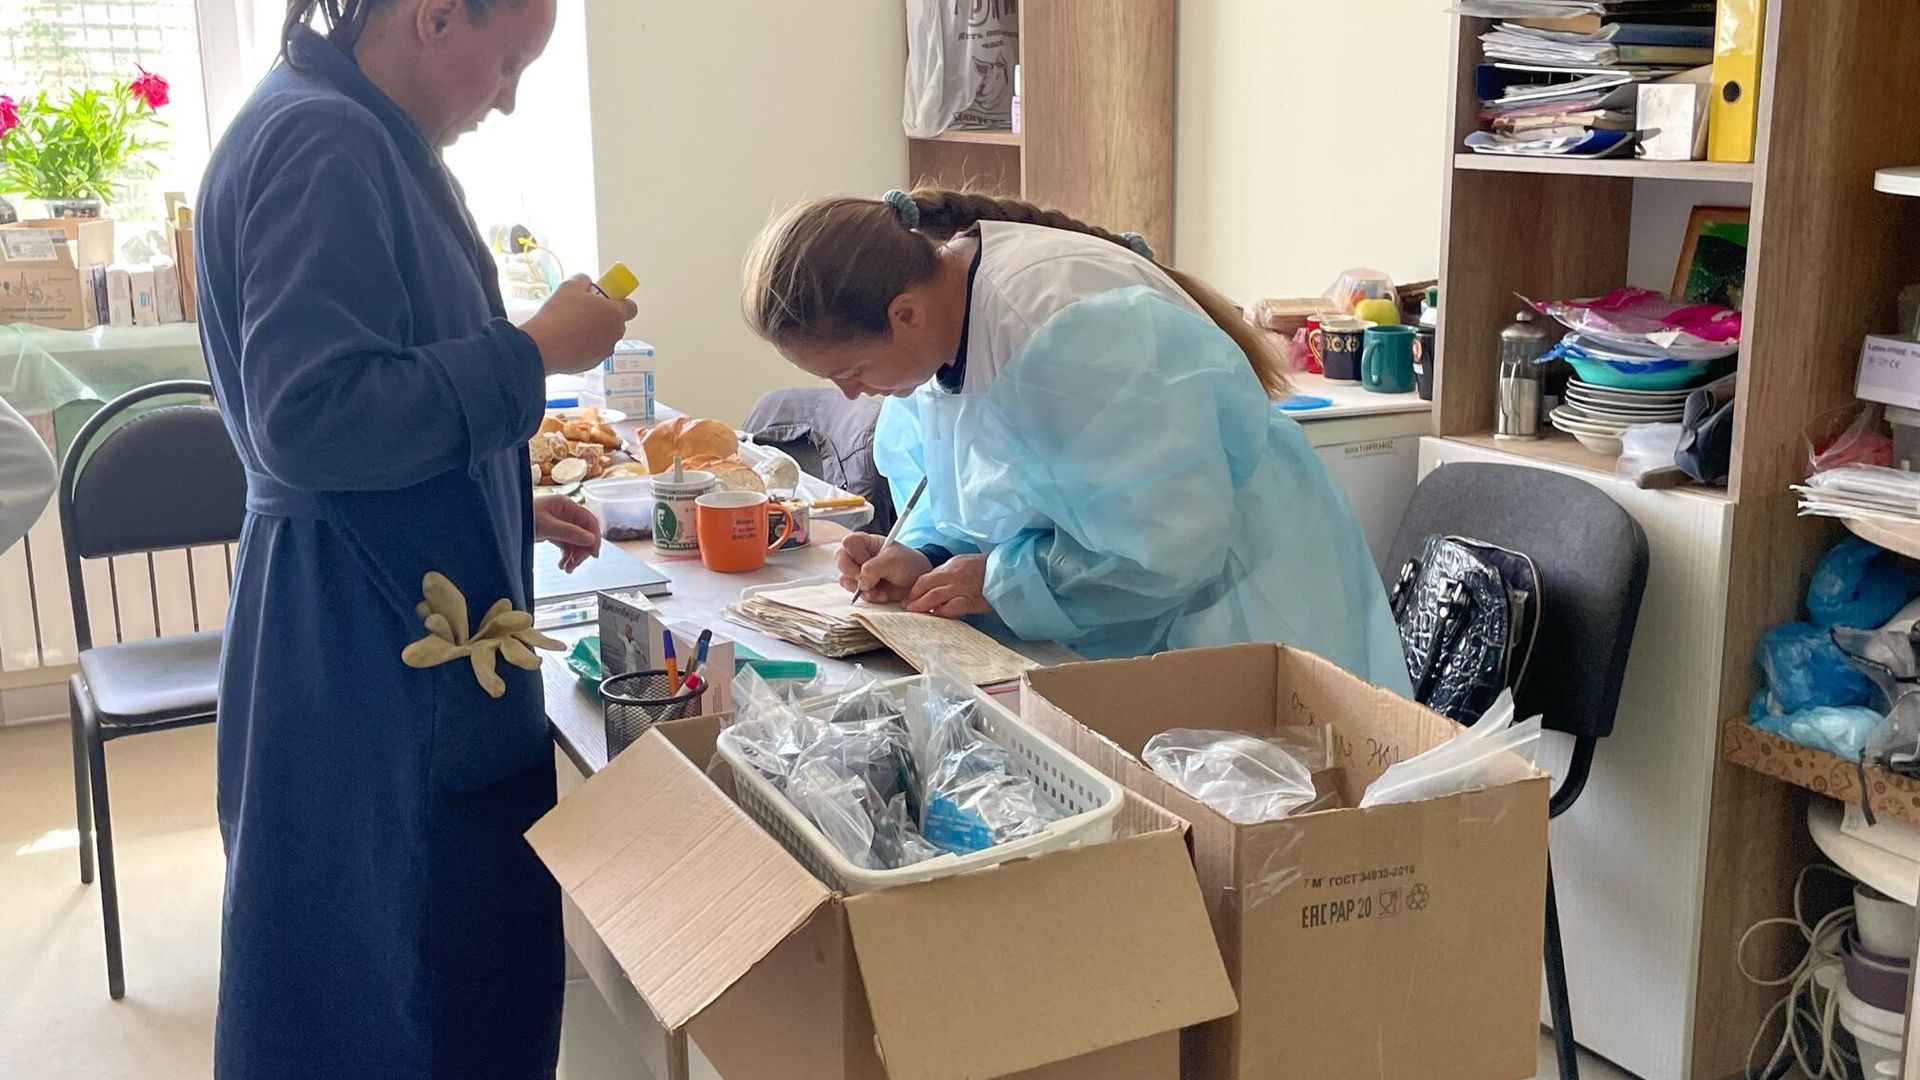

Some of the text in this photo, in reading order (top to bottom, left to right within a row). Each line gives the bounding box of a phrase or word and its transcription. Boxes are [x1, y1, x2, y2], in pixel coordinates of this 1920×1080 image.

[1329, 873, 1357, 888] ГОСТ
[1329, 899, 1354, 924] PAP
[1357, 896, 1371, 919] 20
